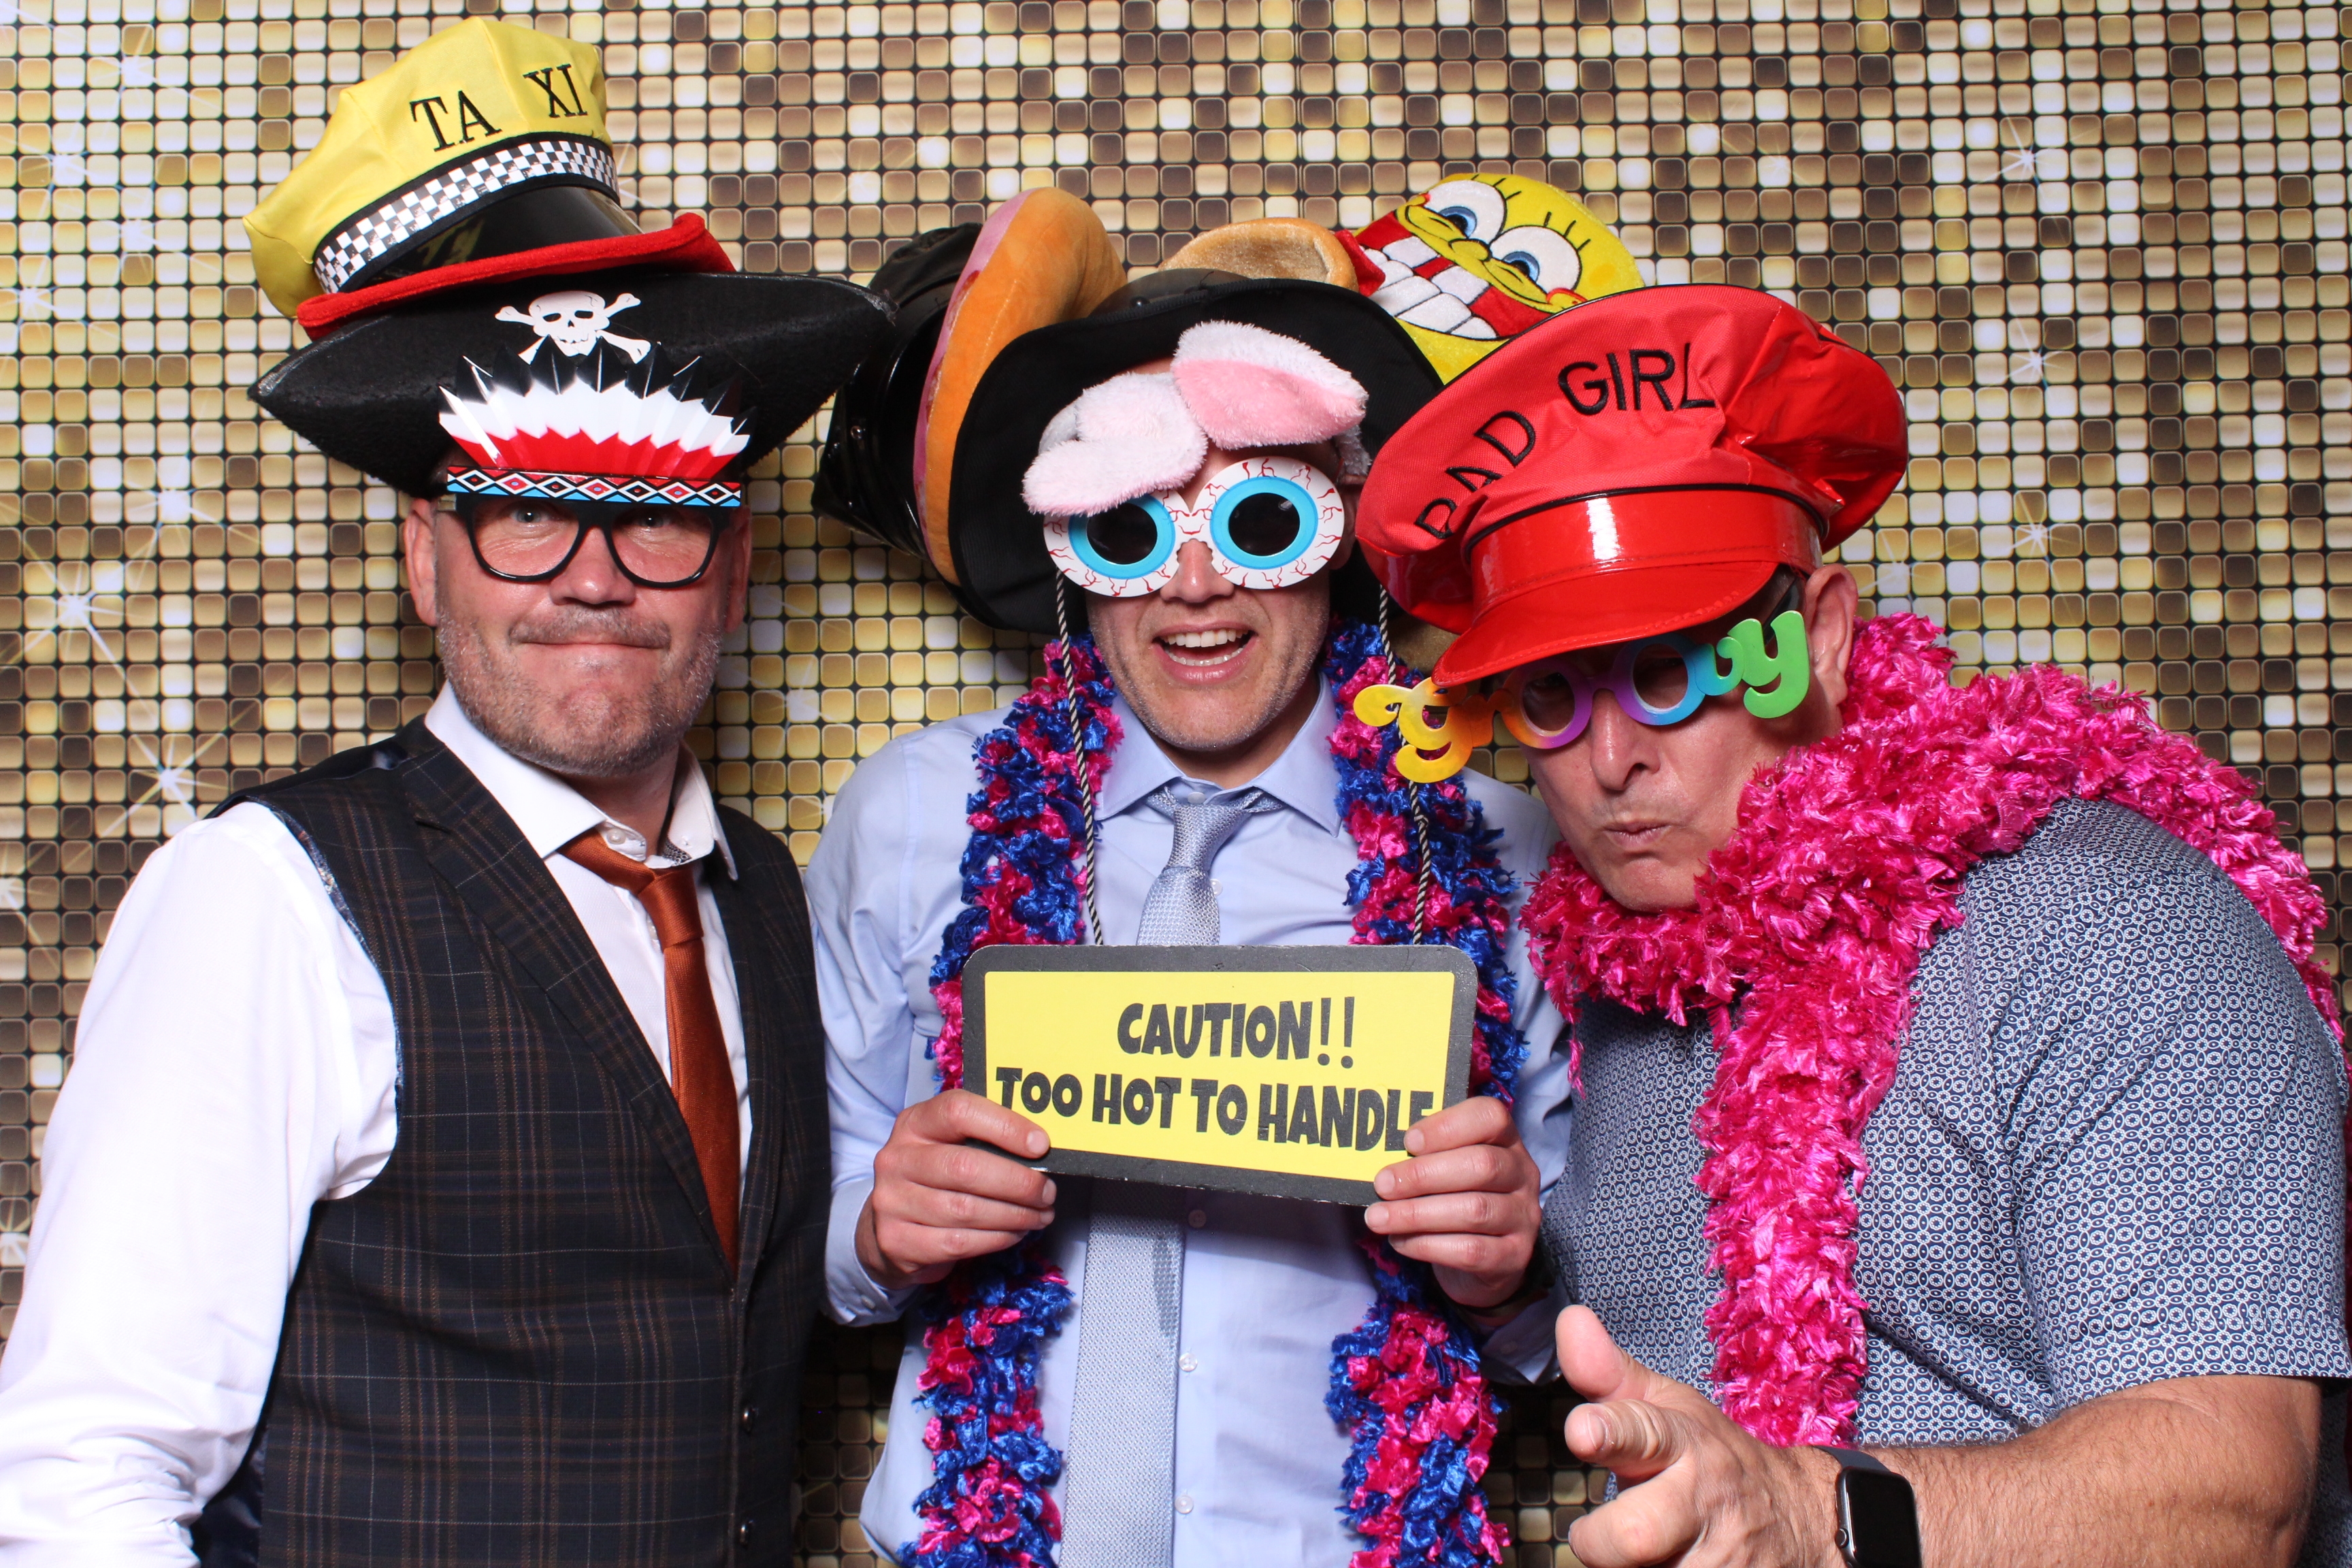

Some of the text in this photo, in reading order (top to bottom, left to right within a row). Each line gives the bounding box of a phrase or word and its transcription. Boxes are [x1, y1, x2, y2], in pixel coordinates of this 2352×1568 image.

[1557, 342, 1716, 416] GIRL
[1116, 996, 1356, 1070] CAUTION!!
[995, 1066, 1083, 1118] TOO
[1092, 1073, 1181, 1130] HOT
[1190, 1078, 1248, 1137] TO
